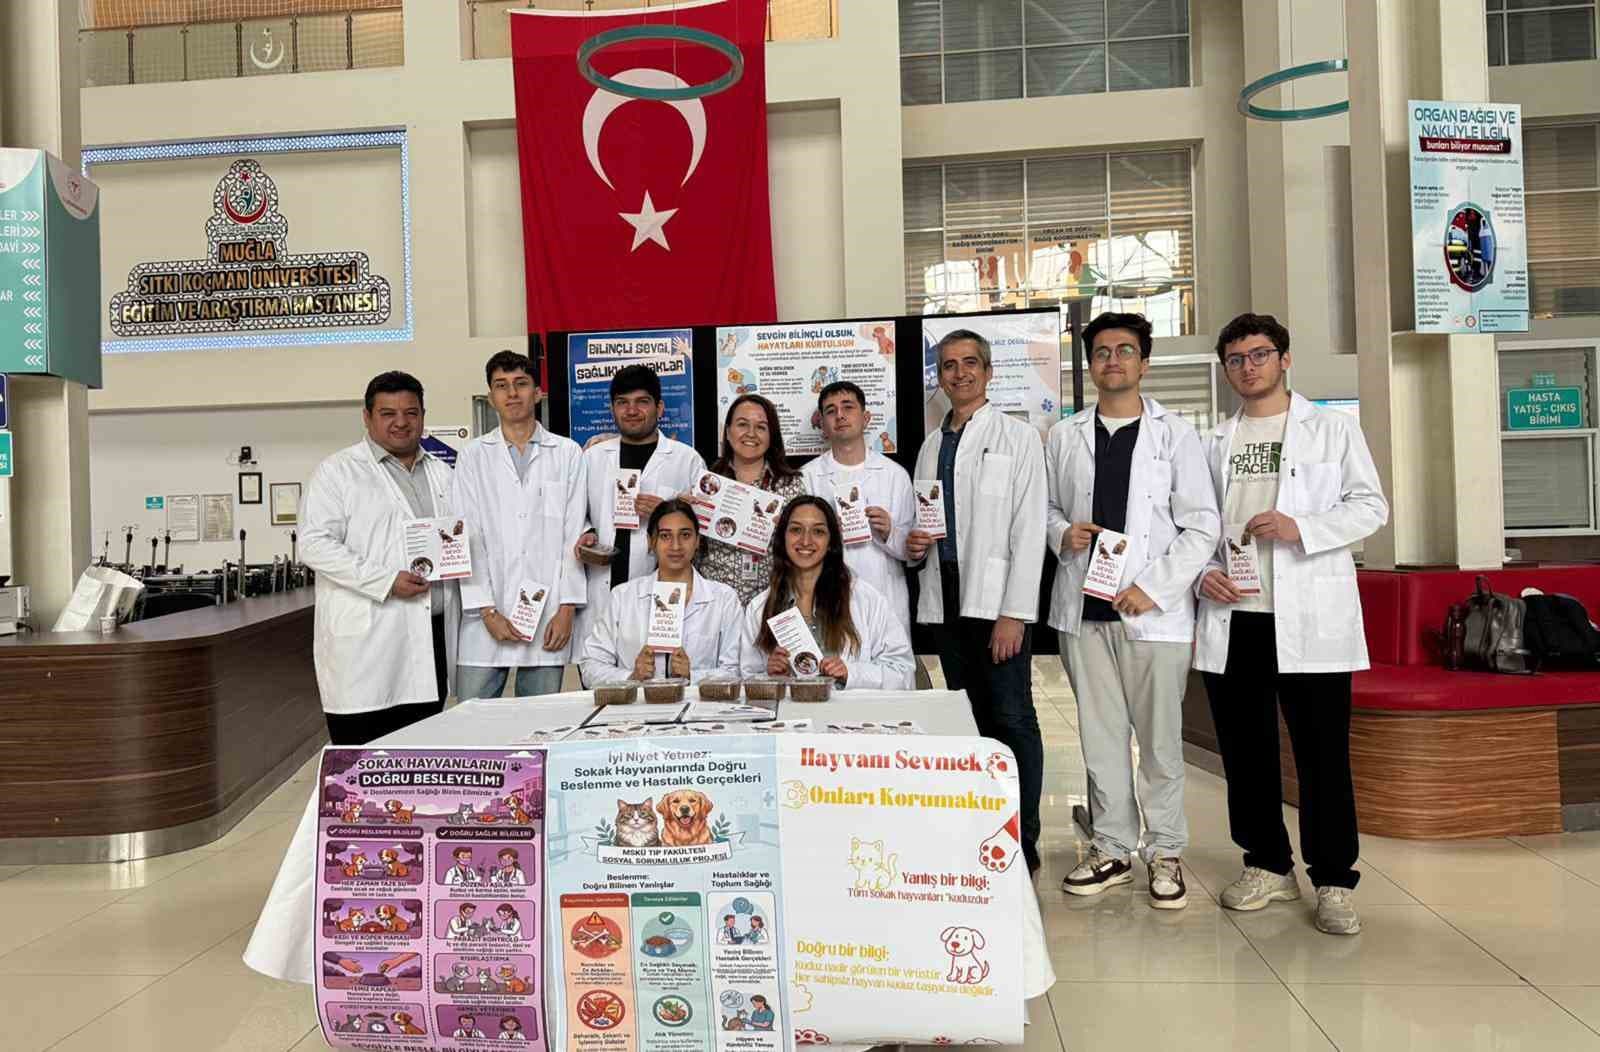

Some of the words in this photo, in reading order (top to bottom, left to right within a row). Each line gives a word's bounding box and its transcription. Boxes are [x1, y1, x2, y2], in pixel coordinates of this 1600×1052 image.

[1414, 108, 1458, 122] ORGAN
[1499, 110, 1516, 124] VE
[1422, 124, 1478, 138] NAKLİYLE
[1450, 141, 1472, 152] biliyor
[219, 239, 275, 263] MUĞLA
[139, 274, 179, 296] SITKI
[182, 271, 249, 297] KOÇMAN
[251, 262, 358, 289] ÜNİVERSİTESİ
[121, 300, 176, 324] EĞİTİM
[178, 302, 197, 321] VE
[200, 297, 289, 326] ARAŞTIRMA
[292, 288, 379, 315] HASTANESİ
[756, 331, 786, 340] SEVGİN
[788, 328, 823, 340] BİLİNÇLİ
[758, 341, 804, 350] HAYATLARI
[1528, 392, 1560, 402] HASTA
[1530, 414, 1561, 425] BİRİMİ
[1245, 442, 1270, 454] THE
[1231, 453, 1270, 465] ORTH
[1236, 463, 1268, 474] FACE
[608, 751, 624, 764] İyi
[626, 750, 659, 764] Niyet
[660, 750, 712, 762] Yetmez:
[895, 750, 982, 772] Sevmek
[358, 758, 404, 772] SOKAK
[406, 758, 507, 772] HAYVANLARINI
[574, 767, 612, 777] Sokak
[615, 764, 705, 776] Hayvanlarında
[708, 761, 747, 774] Doğru
[362, 772, 410, 785] DOĞRU
[413, 773, 500, 786] BESLEYELİM!
[560, 780, 622, 791] Beslenme
[626, 780, 640, 788] ve
[643, 776, 694, 788] Hastalık
[696, 772, 762, 788] Gerçekleri
[810, 784, 875, 806] Onları
[880, 787, 1006, 812] Korumaktır
[622, 848, 647, 856] MSKÜ
[664, 846, 706, 855] FAKÜLTESİ
[602, 856, 634, 864] SOSYAL
[636, 856, 691, 864] SORUMLULUK
[692, 854, 728, 864] PROJESİ
[583, 881, 608, 890] Doğru
[609, 882, 638, 890] Bilinen
[711, 879, 742, 888] Toplum
[902, 872, 938, 888] Yanlış
[940, 872, 958, 886] bir
[848, 887, 868, 898] Tüm
[870, 888, 896, 900] sokak
[898, 890, 944, 902] hayvanları
[796, 940, 837, 956] Doğru
[839, 942, 857, 956] bir
